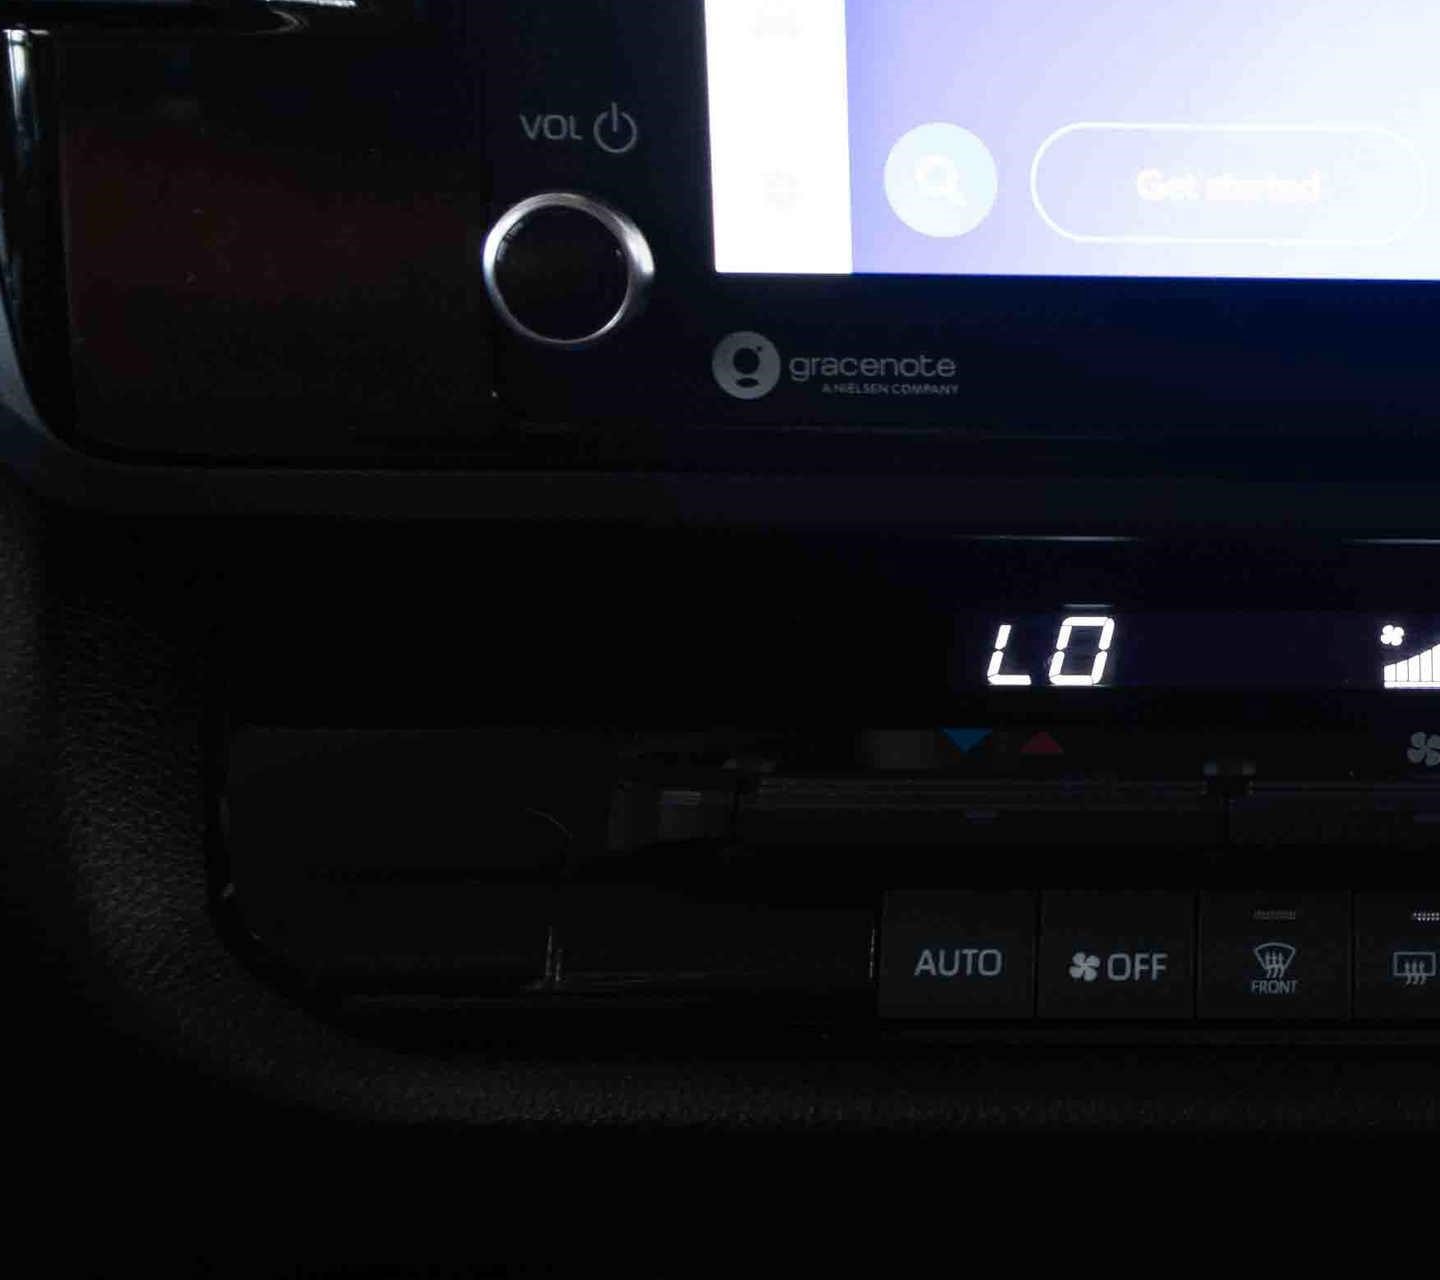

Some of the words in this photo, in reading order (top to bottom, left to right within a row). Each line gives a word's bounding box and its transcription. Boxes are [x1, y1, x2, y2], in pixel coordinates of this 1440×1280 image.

[520, 113, 584, 143] VOL
[1137, 168, 1201, 201] Get
[1205, 168, 1321, 202] started
[789, 354, 957, 383] gracenote
[834, 383, 890, 396] NIELSEN
[891, 384, 959, 397] COMPANY
[913, 948, 1004, 977] AUTO
[1107, 951, 1168, 981] OFF
[1251, 979, 1298, 994] FRONT
